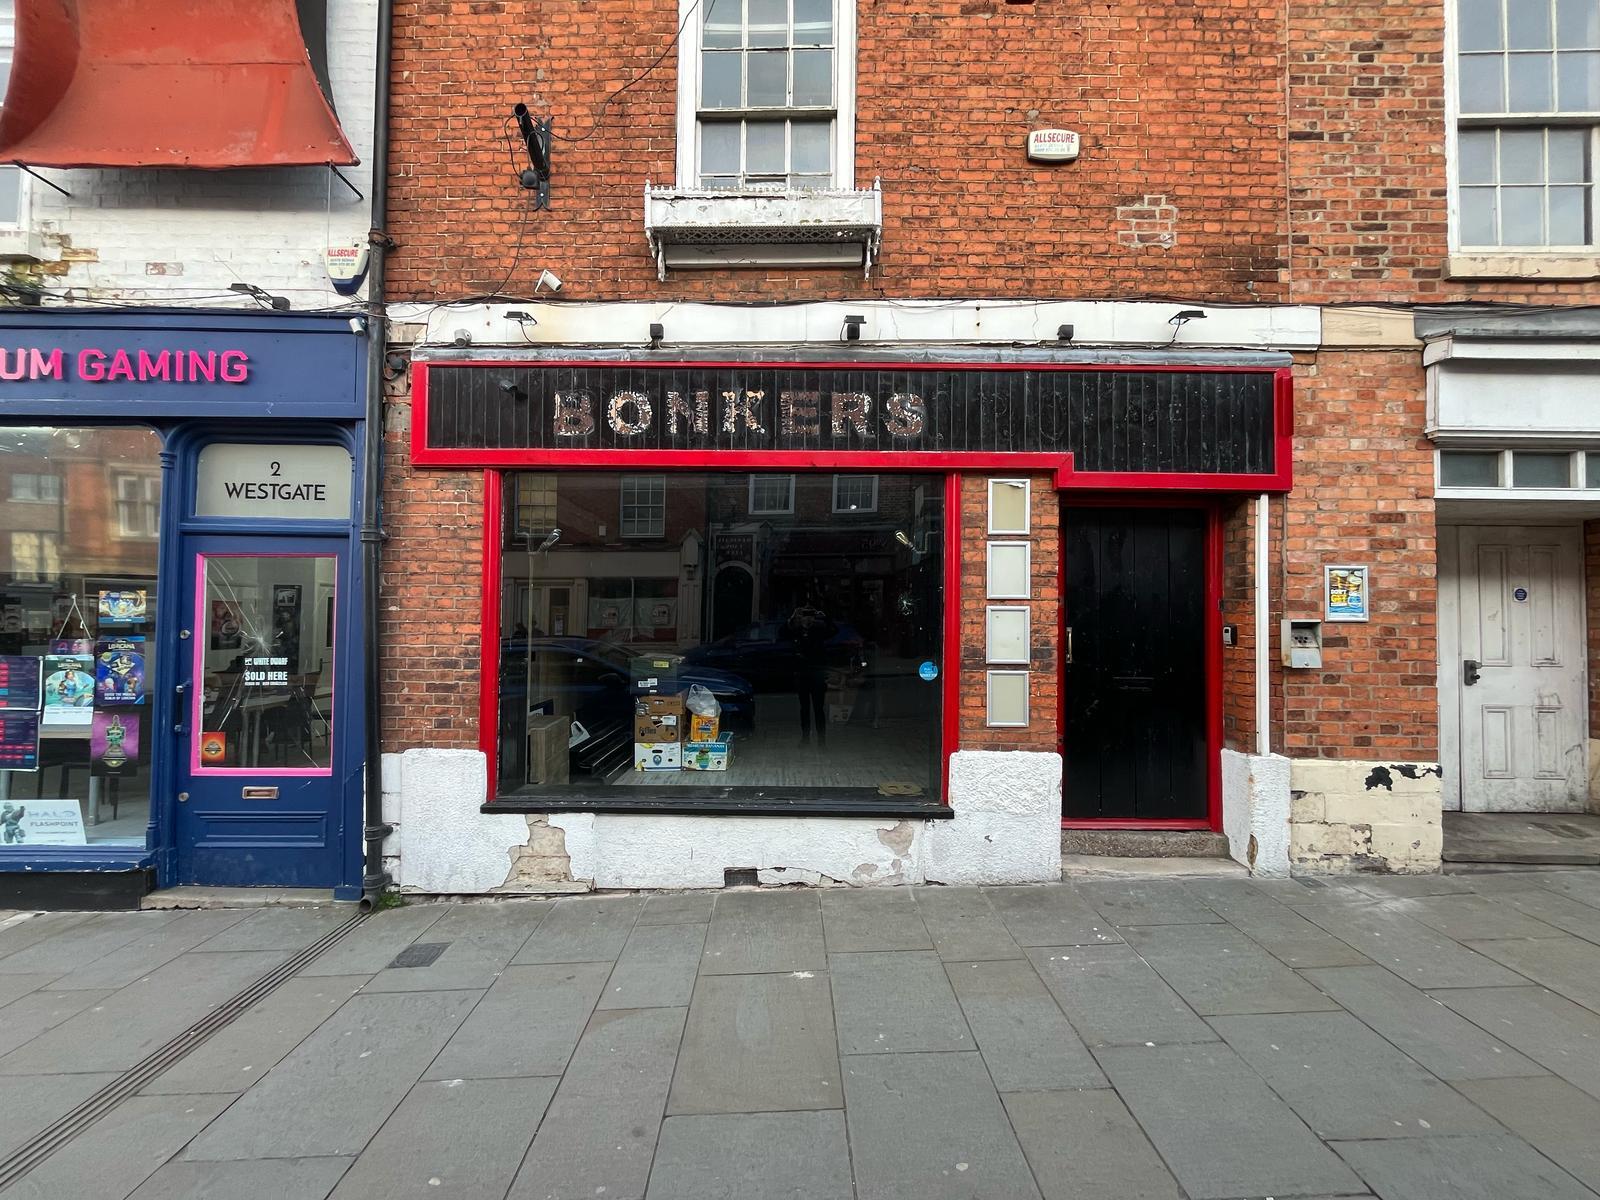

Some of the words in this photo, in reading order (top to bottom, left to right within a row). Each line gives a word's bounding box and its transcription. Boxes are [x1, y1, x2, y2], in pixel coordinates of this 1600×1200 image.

[1034, 132, 1075, 143] ALLSECURE
[328, 249, 359, 257] ALLSECURE
[0, 347, 63, 380] UM
[78, 348, 250, 383] GAMING
[553, 390, 926, 437] BONKERS
[270, 461, 281, 477] 2
[224, 482, 326, 501] WESTGATE
[244, 671, 266, 681] SOLD
[267, 671, 288, 681] HERE
